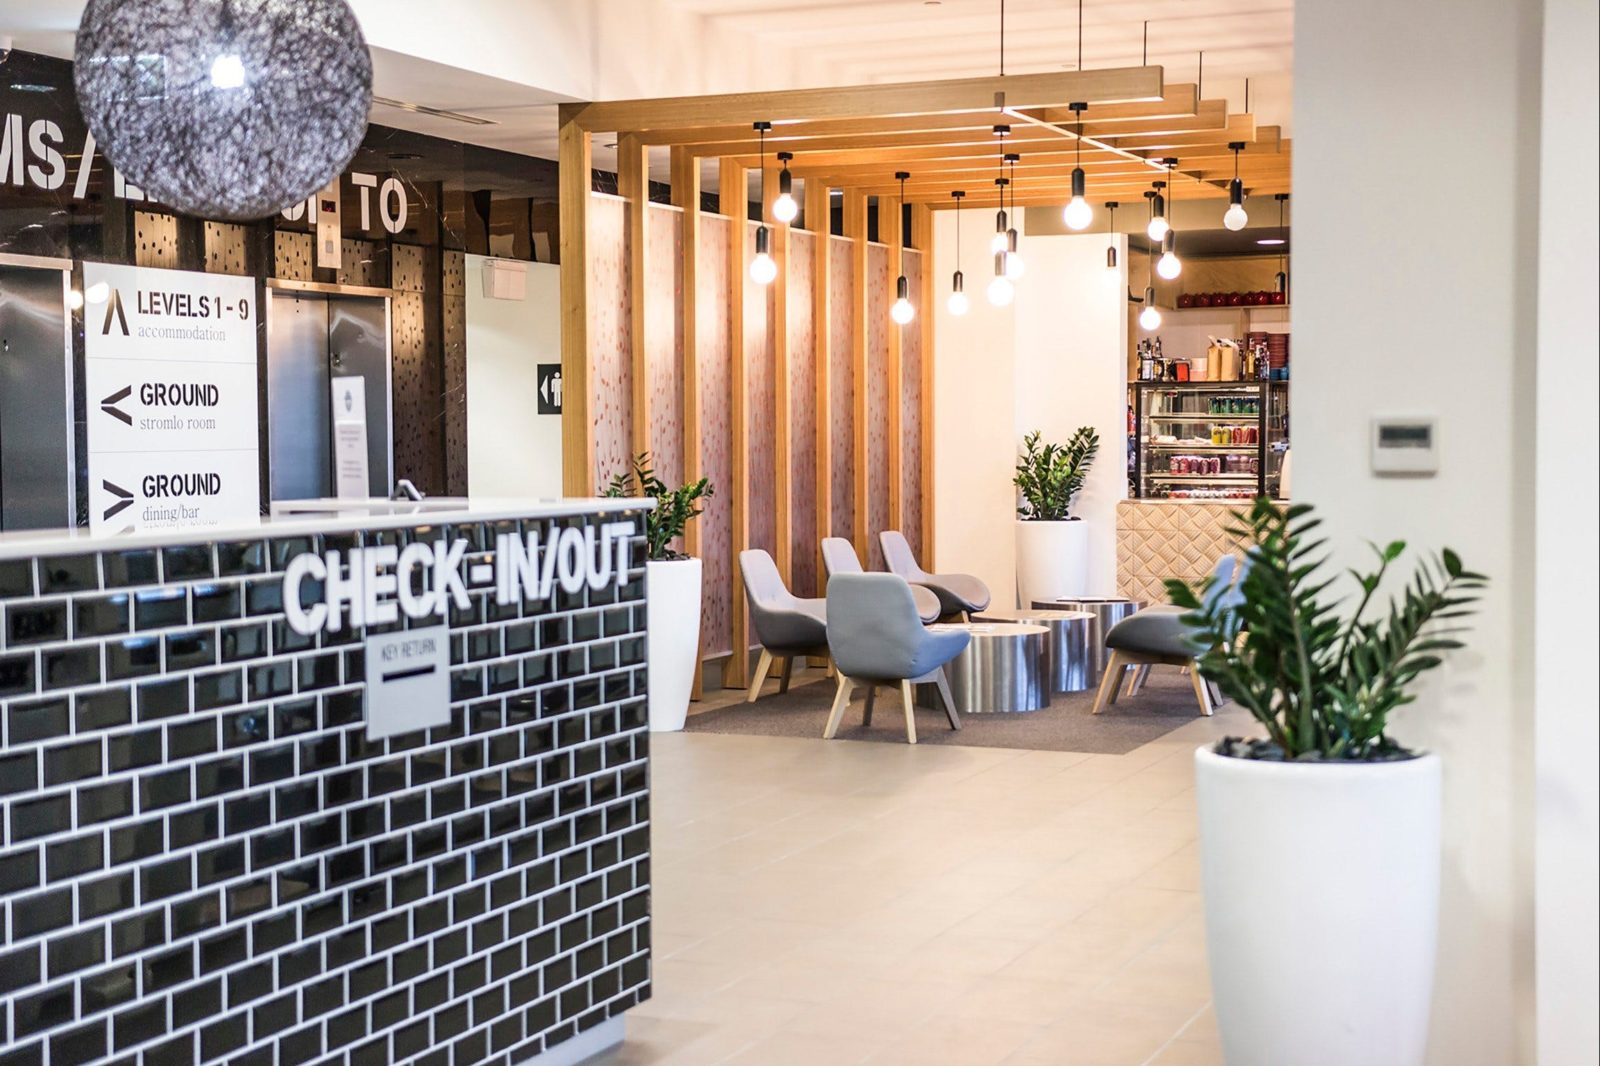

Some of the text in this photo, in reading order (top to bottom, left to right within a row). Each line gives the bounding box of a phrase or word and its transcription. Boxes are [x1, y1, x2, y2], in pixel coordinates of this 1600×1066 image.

[351, 171, 408, 234] TO
[137, 290, 210, 318] LEVELS
[138, 325, 226, 342] accommodation
[140, 383, 219, 407] GROUND
[140, 415, 216, 430] stromlo room
[142, 473, 221, 498] GROUND
[142, 503, 200, 522] dining/bar
[283, 521, 635, 635] CHECK-IN/OUT
[382, 637, 436, 661] KEY RETURN
